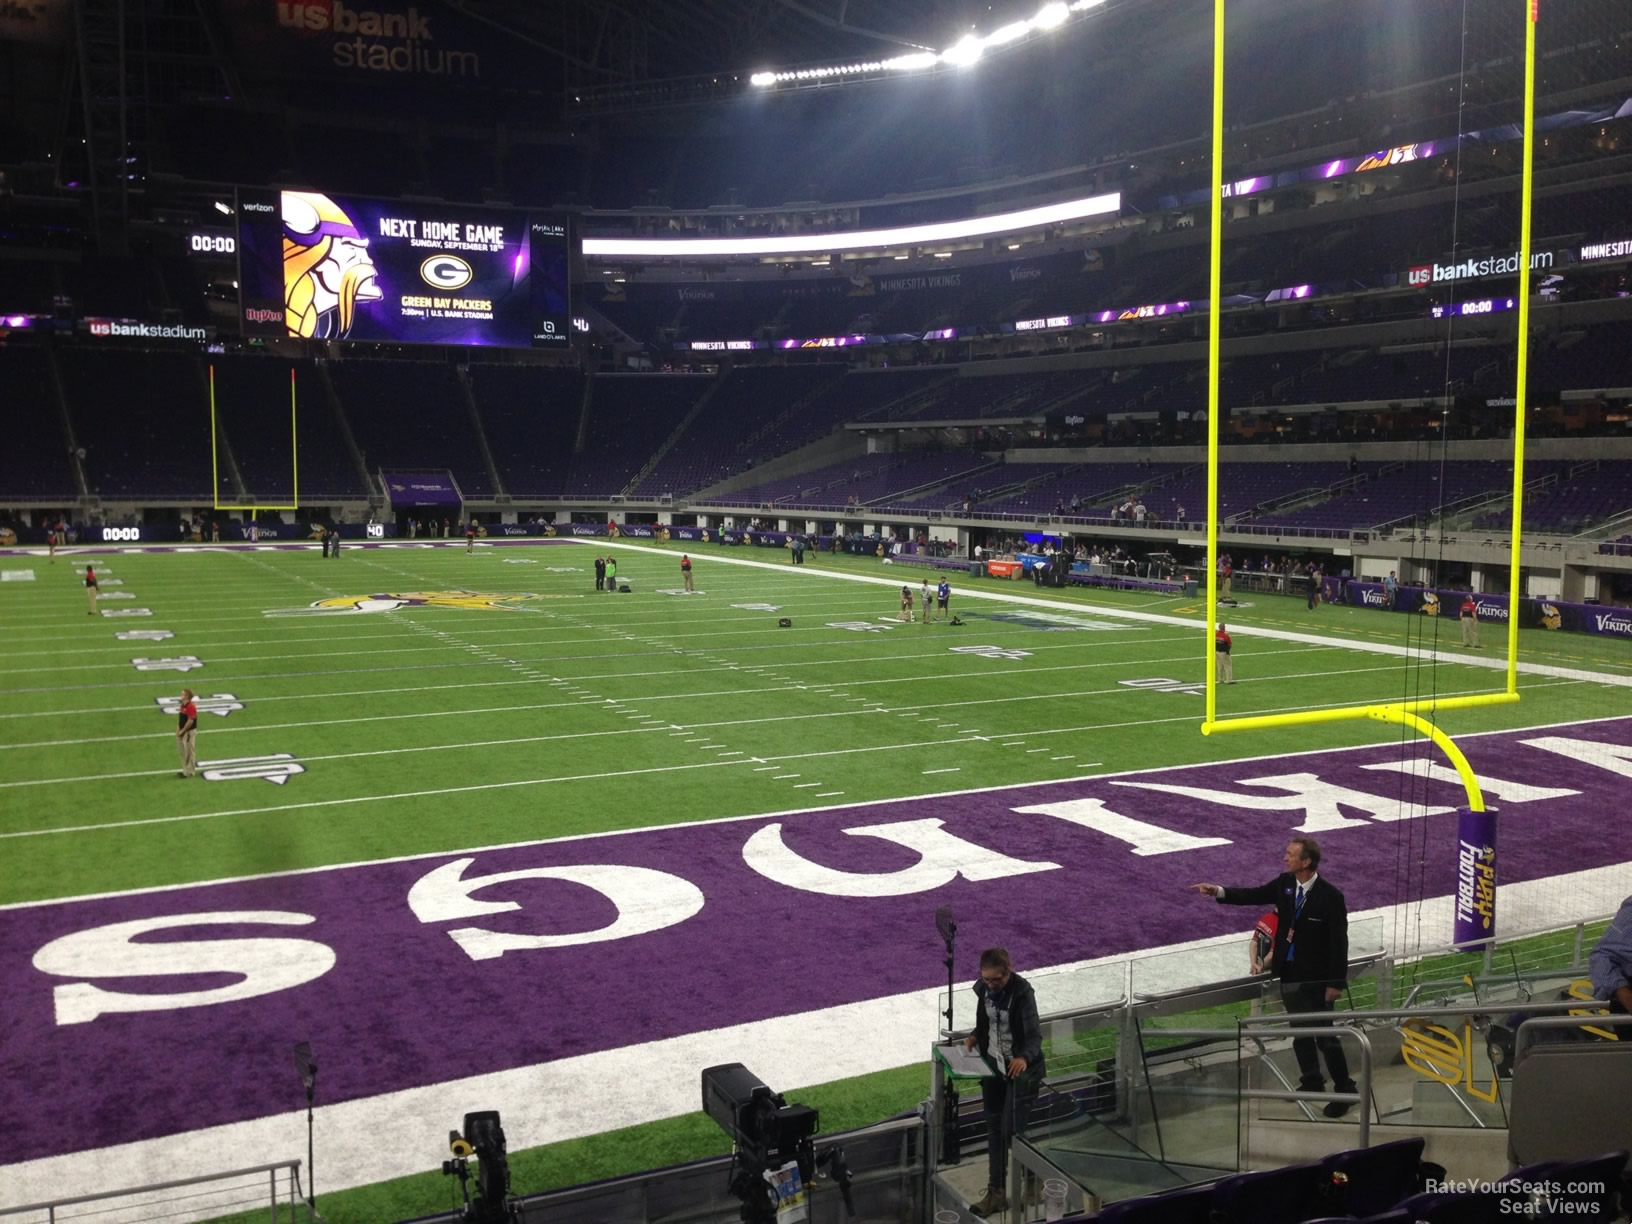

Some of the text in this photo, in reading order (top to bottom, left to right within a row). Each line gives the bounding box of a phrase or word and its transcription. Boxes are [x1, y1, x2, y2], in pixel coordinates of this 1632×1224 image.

[333, 36, 480, 77] stadium
[243, 203, 274, 212] verizon
[380, 217, 504, 245] NEXT HOME GAME
[192, 234, 235, 253] 00:00
[443, 241, 488, 252] SEPTEMBER
[880, 273, 961, 291] MINNESOTA VIKINGS
[401, 296, 492, 311] GREEN BAY PACKERS
[1461, 300, 1493, 314] 00:00
[444, 310, 463, 318] BANK
[463, 312, 494, 320] STADIUM
[1015, 316, 1070, 331] MINNESOTA VIKINGS
[691, 341, 752, 350] MINNESOTA VIKINGS
[103, 527, 140, 541] 00:00
[368, 525, 383, 537] 40
[1457, 839, 1484, 924] FOOTBALL
[1473, 863, 1495, 917] PLAY
